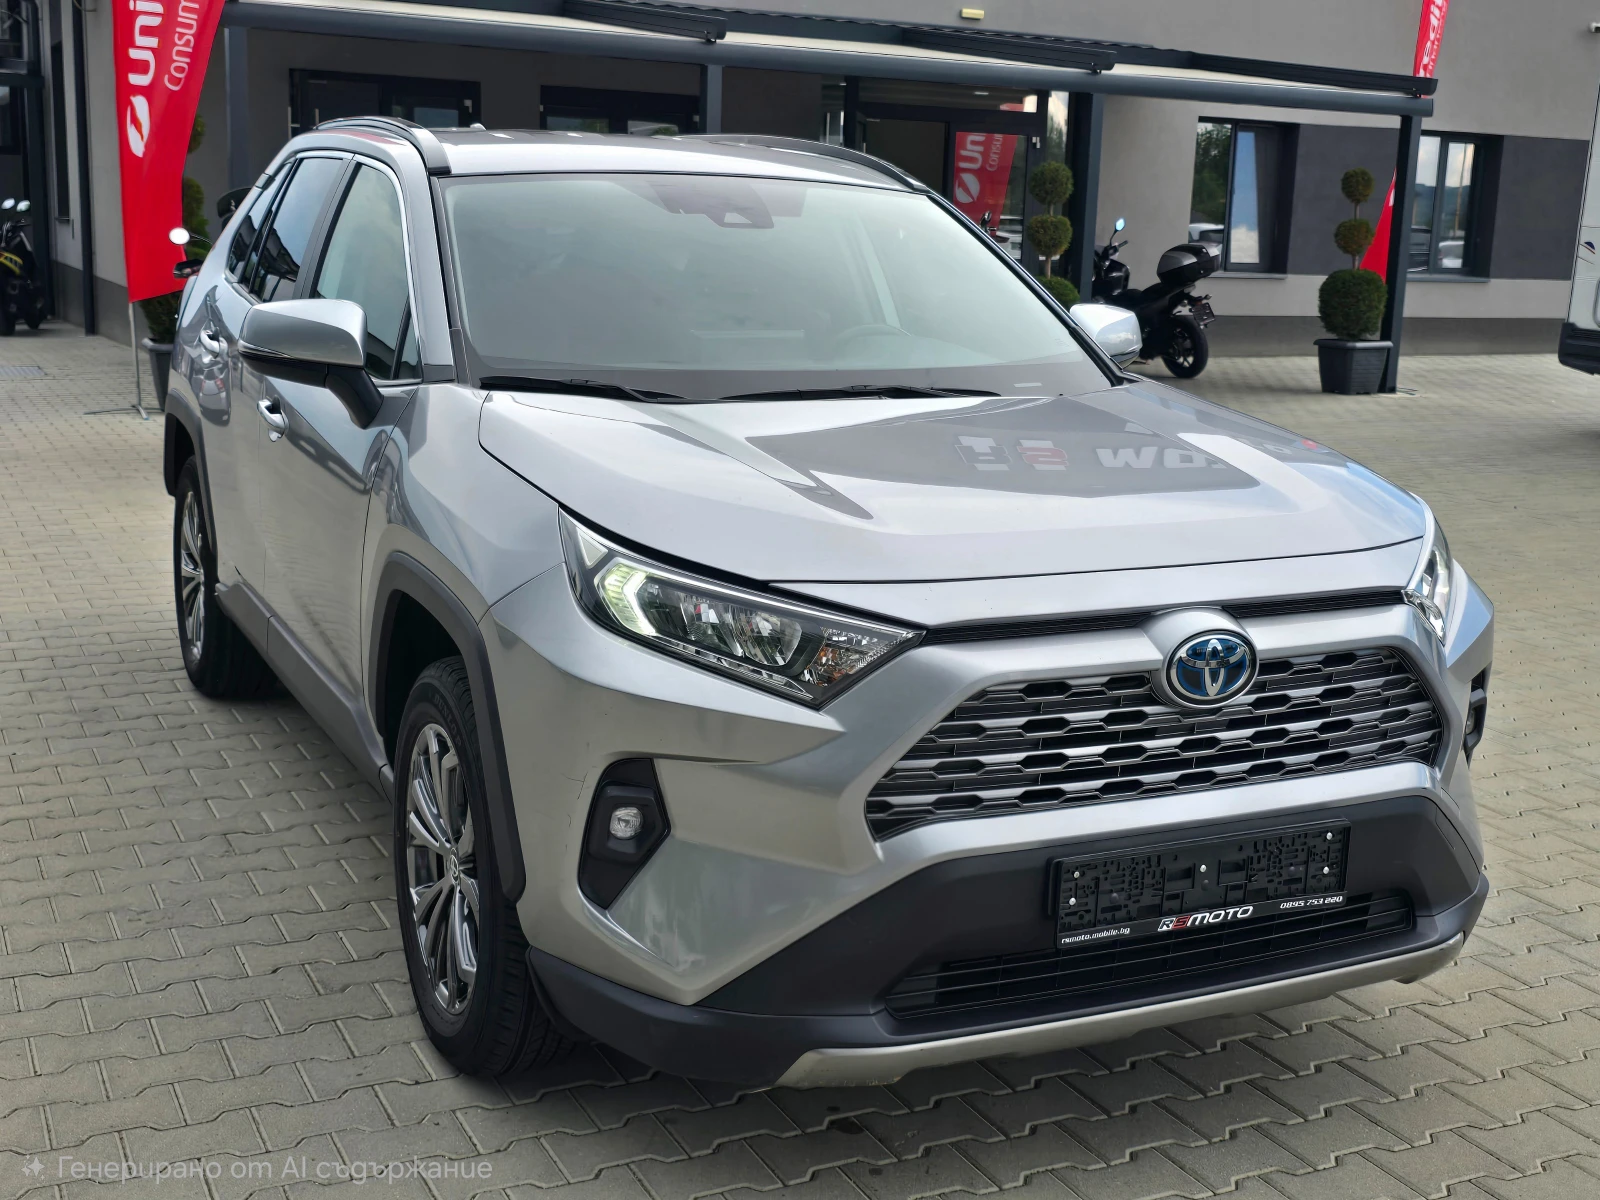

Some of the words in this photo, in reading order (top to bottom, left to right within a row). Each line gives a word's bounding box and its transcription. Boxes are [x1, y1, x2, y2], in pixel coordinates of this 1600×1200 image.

[128, 0, 164, 86] Uni
[958, 132, 986, 170] Un
[1061, 927, 1131, 944] rsmoto.mobile.bg
[1279, 900, 1305, 909] 0895
[1306, 898, 1324, 906] 753
[1324, 895, 1343, 904] 220
